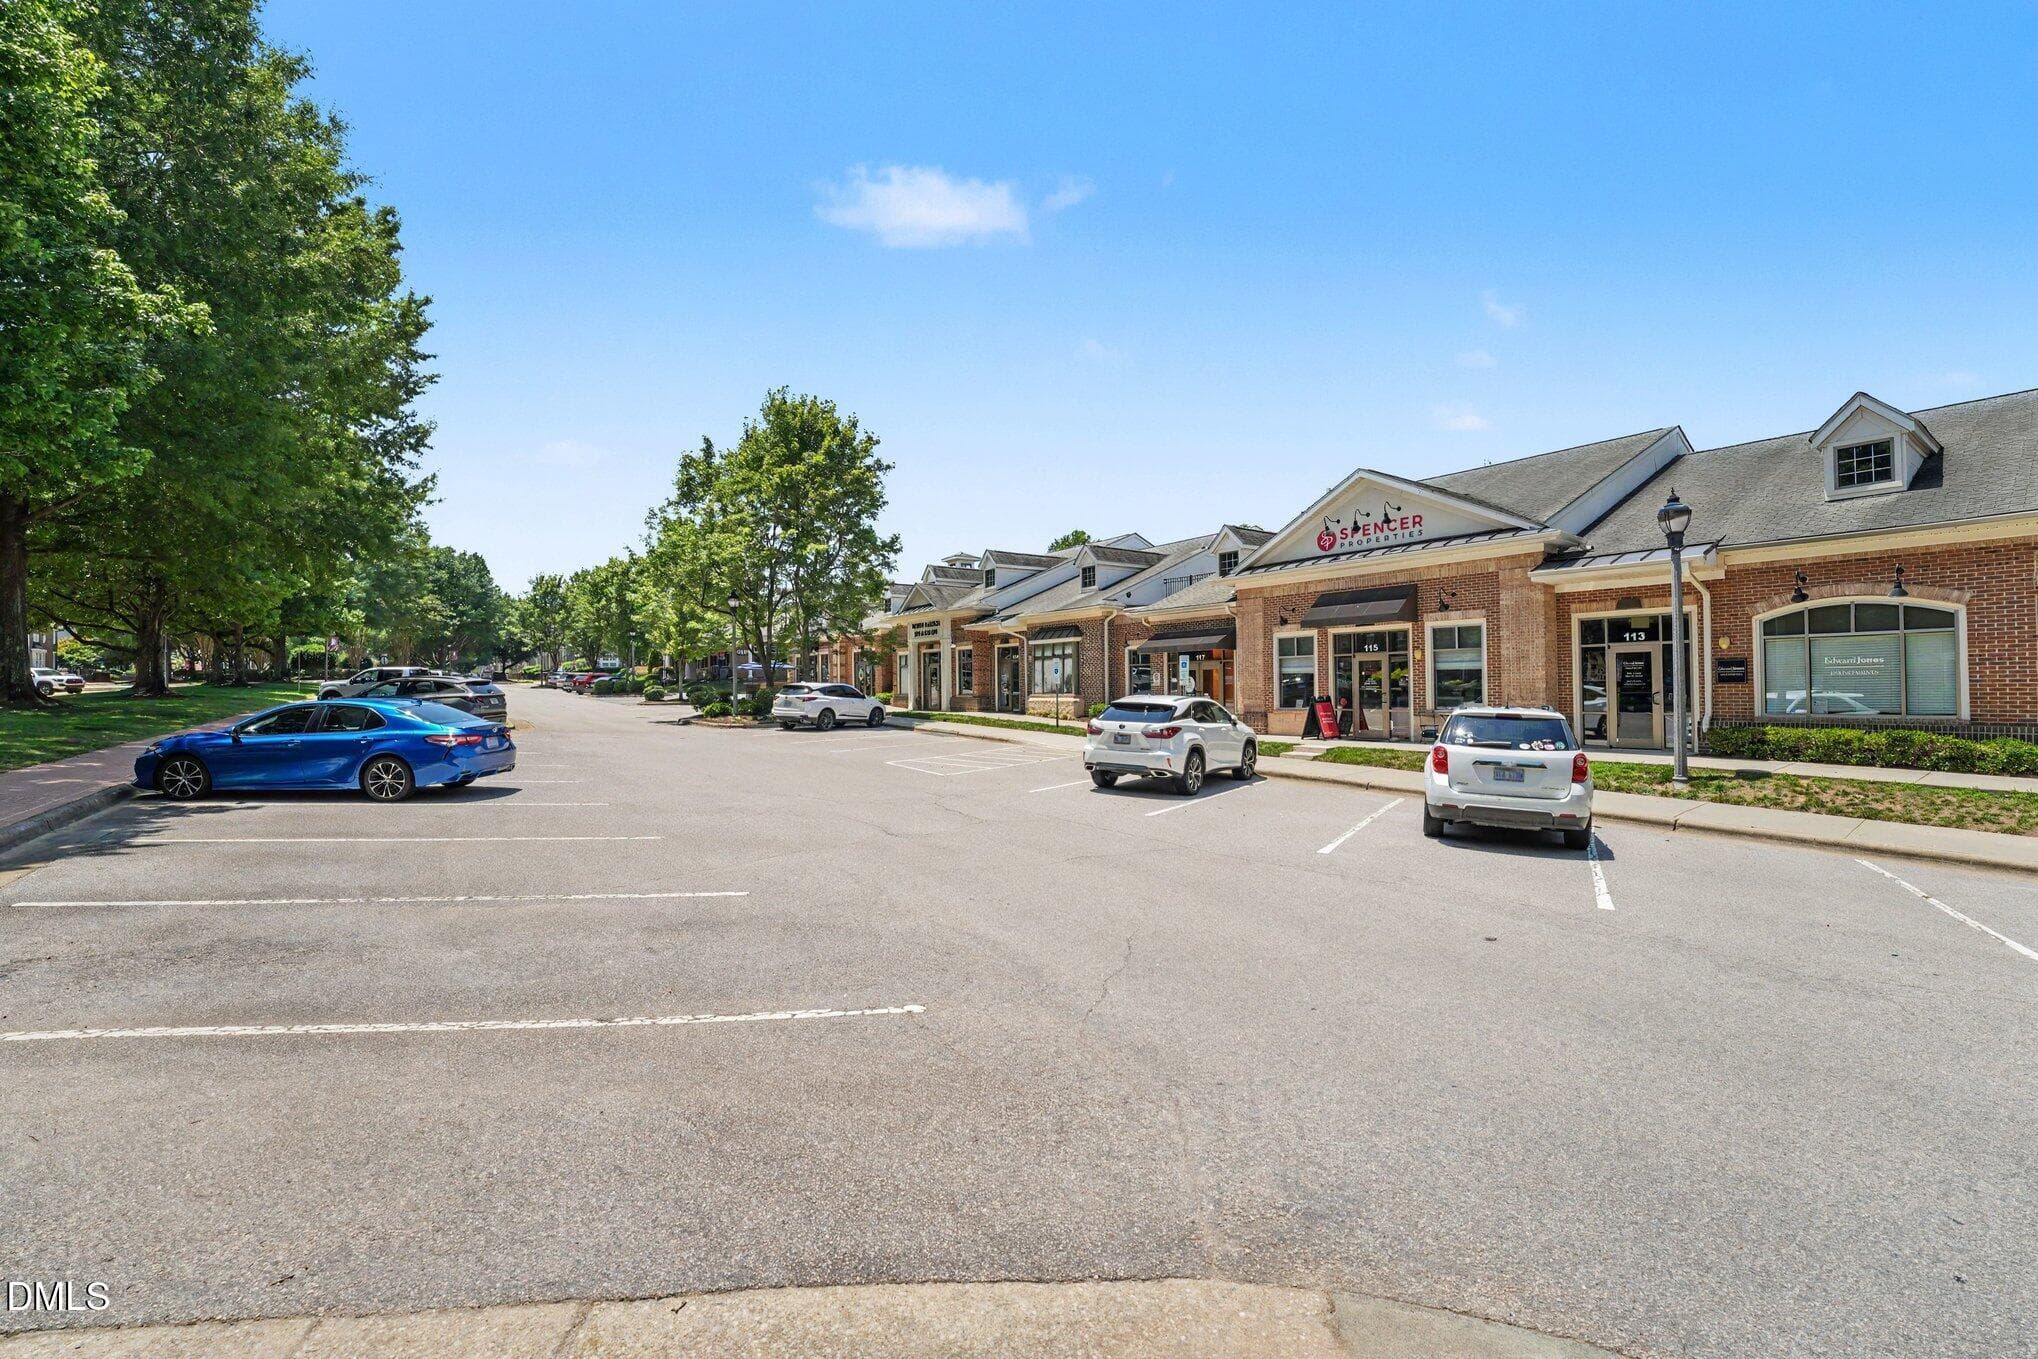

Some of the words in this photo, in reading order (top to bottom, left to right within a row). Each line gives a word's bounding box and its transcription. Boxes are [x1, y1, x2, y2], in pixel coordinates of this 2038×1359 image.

[1340, 529, 1423, 548] PROPERTIES
[1624, 632, 1645, 641] 113
[1364, 643, 1378, 652] 115
[1857, 656, 1884, 664] Jones
